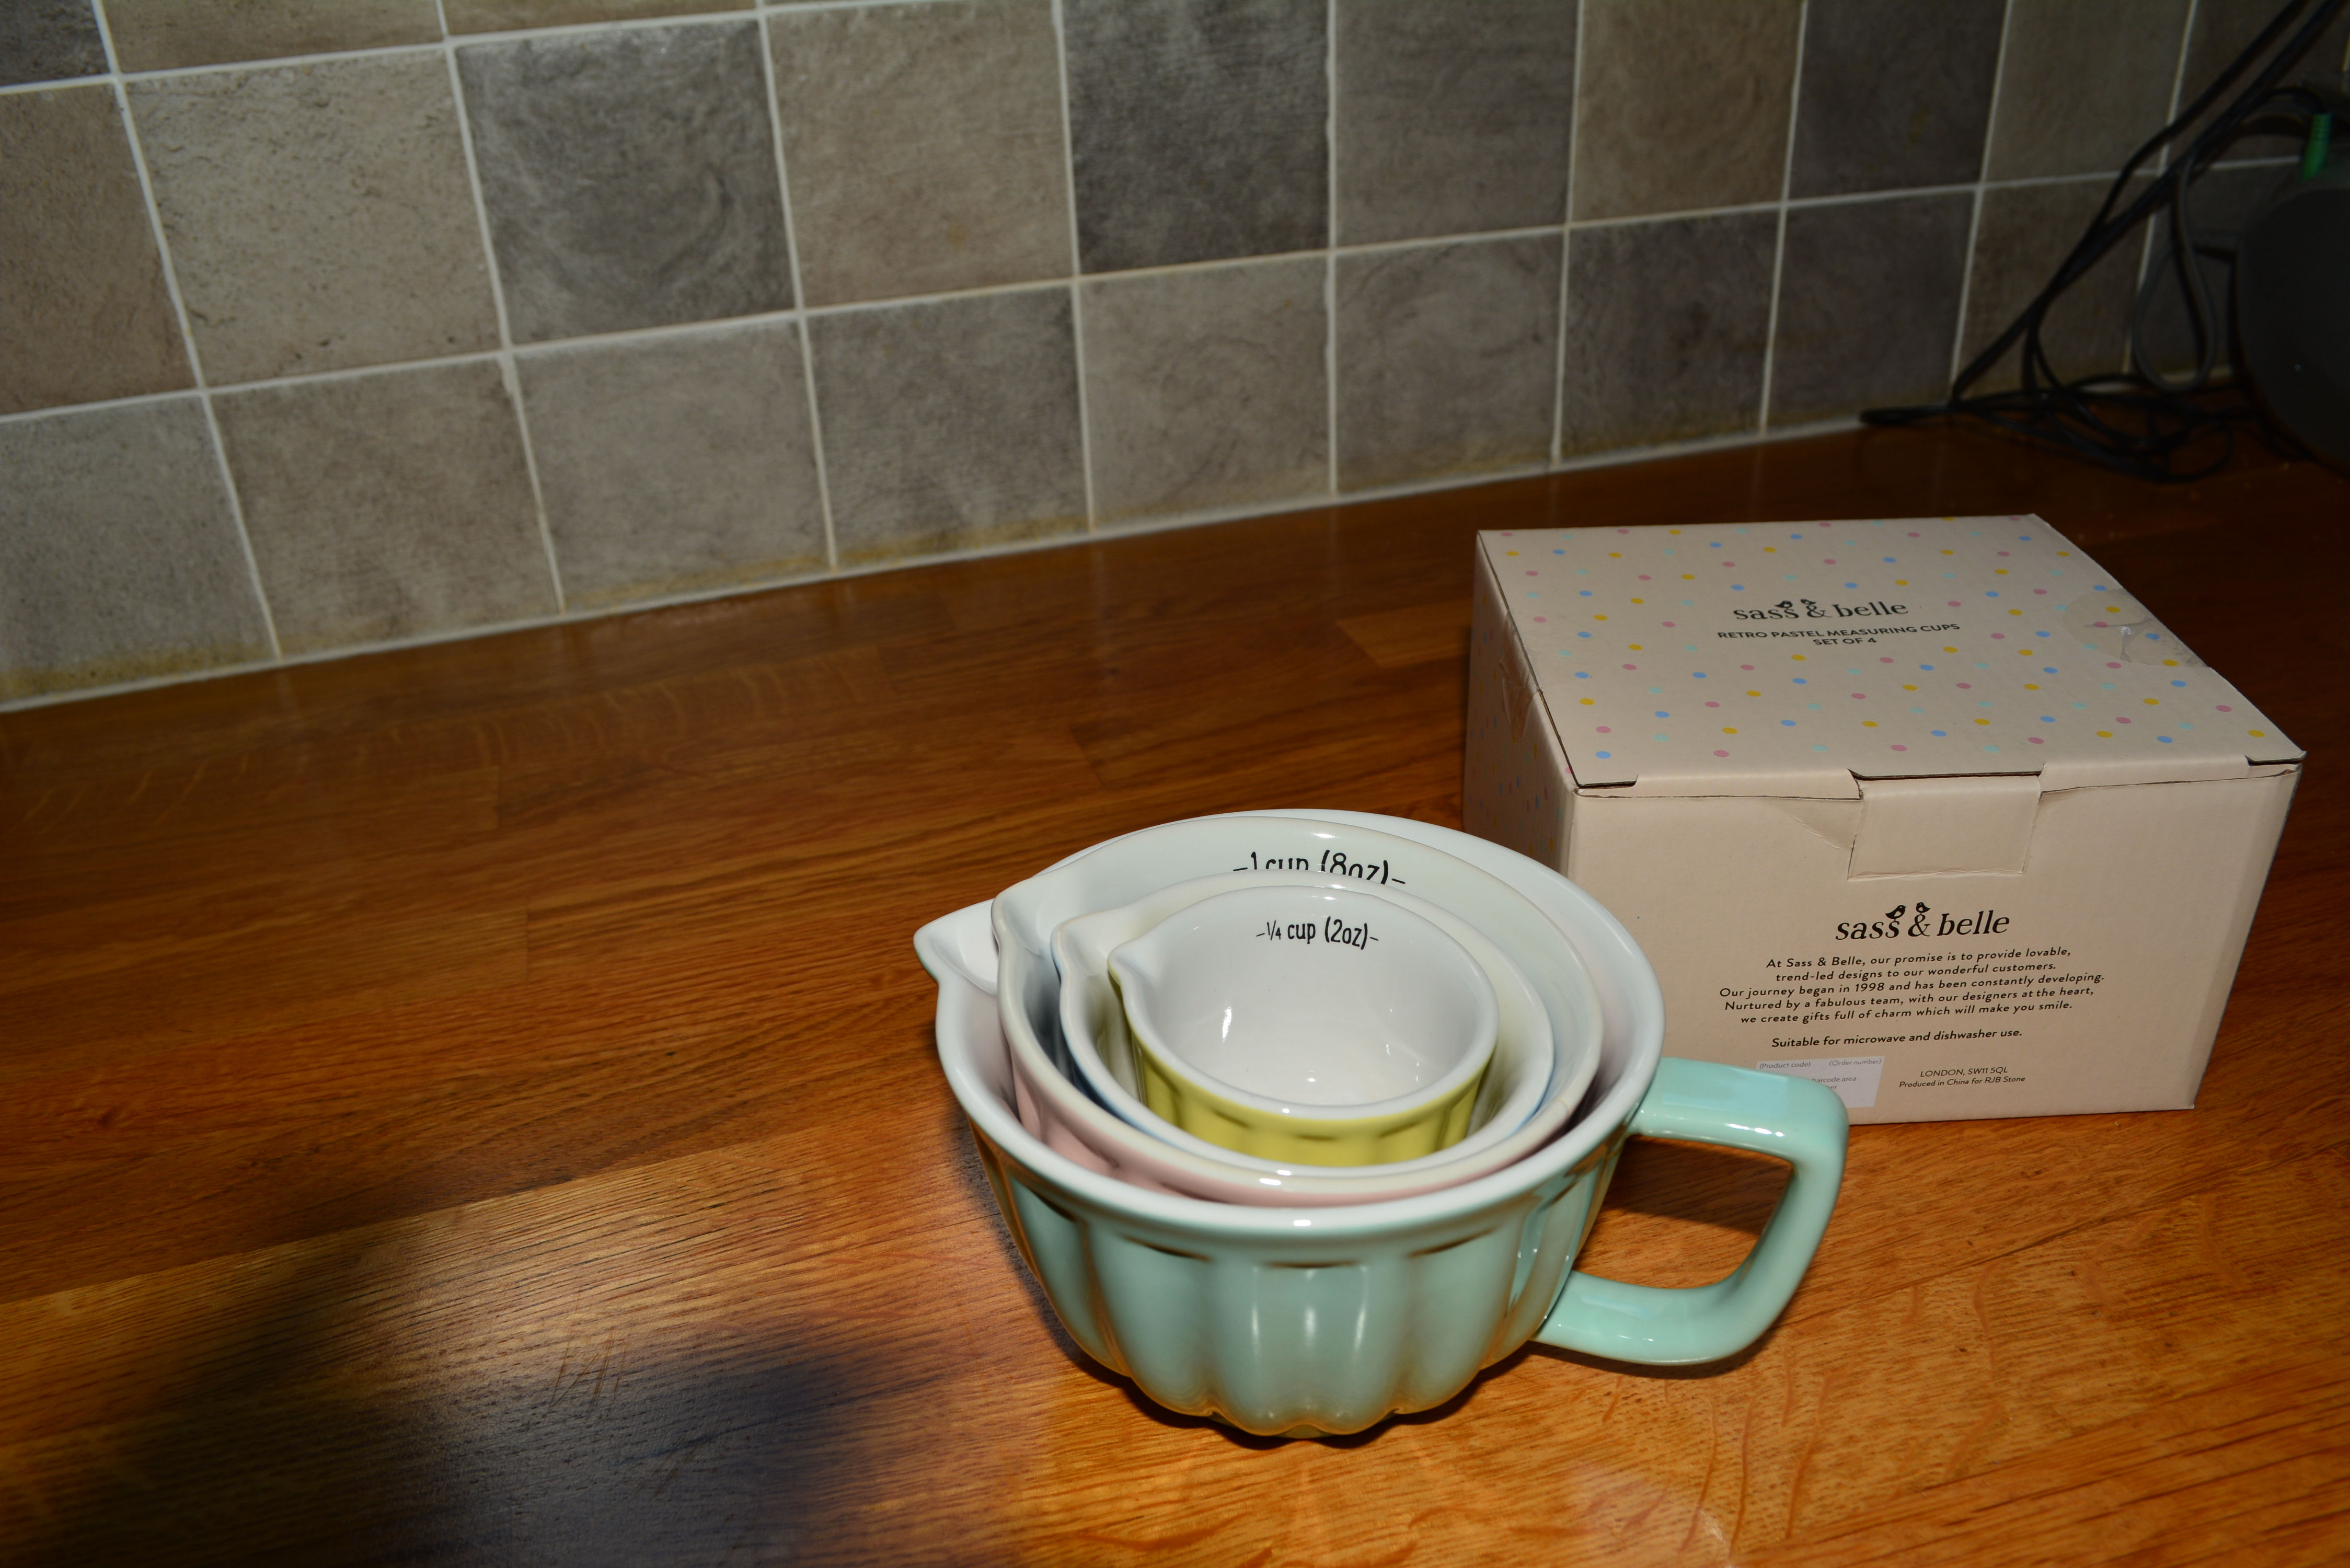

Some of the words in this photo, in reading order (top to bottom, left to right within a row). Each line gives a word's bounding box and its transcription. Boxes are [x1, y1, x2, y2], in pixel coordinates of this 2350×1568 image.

[1733, 605, 1800, 620] sass
[1806, 602, 1831, 618] &
[1832, 601, 1908, 617] belle
[1827, 626, 1918, 637] MEASURING
[1920, 624, 1960, 632] CUPS
[1287, 923, 1316, 944] cup
[1324, 916, 1368, 950] (2oz)
[1835, 918, 1900, 940] sass
[1907, 912, 1931, 937] &
[1937, 909, 2010, 937] belle
[1766, 959, 1782, 968] At
[1786, 958, 1812, 967] Sass
[1817, 957, 1826, 966] &
[1831, 956, 1865, 966] Belle,
[1894, 953, 1943, 966] promise
[1947, 952, 1956, 961] is
[1976, 949, 2022, 963] provide
[2025, 946, 2071, 957] lovable,
[1776, 971, 1834, 982] trend-led
[1838, 970, 1882, 982] designs
[1928, 964, 1989, 975] wonderful
[1992, 964, 2056, 972] customers.
[1720, 988, 1744, 997] Our
[1745, 987, 1795, 1000] journey
[1799, 985, 1834, 997] began
[1839, 984, 1850, 993] in
[1856, 982, 1885, 992] 1998
[1889, 981, 1911, 990] and
[1915, 981, 1934, 989] has
[1938, 979, 1967, 988] been
[1971, 975, 2034, 987] constantly
[2038, 972, 2104, 985] developing.
[1725, 999, 1782, 1010] Nurtured
[1786, 999, 1801, 1011] by
[1815, 997, 1865, 1007] fabulous
[1909, 994, 1934, 1003] with
[1962, 991, 2018, 1003] designers
[2036, 988, 2055, 997] the
[2059, 987, 2093, 996] heart,
[1802, 1011, 1829, 1024] gifts
[1835, 1010, 1854, 1020] full
[1858, 1009, 1872, 1019] of
[1874, 1009, 1911, 1018] charm
[1916, 1006, 1950, 1016] which
[1955, 1005, 1975, 1014] will
[1978, 1004, 2010, 1013] make
[2012, 1005, 2035, 1014] you
[2038, 1000, 2072, 1010] smile.
[1771, 1036, 1819, 1047] Suitable
[1823, 1036, 1841, 1045] for
[1844, 1035, 1906, 1044] microwave
[1909, 1031, 1931, 1042] and
[1933, 1029, 1998, 1041] dishwasher
[1920, 1069, 1965, 1077] LONDON,
[1990, 1066, 2008, 1075] 5QL
